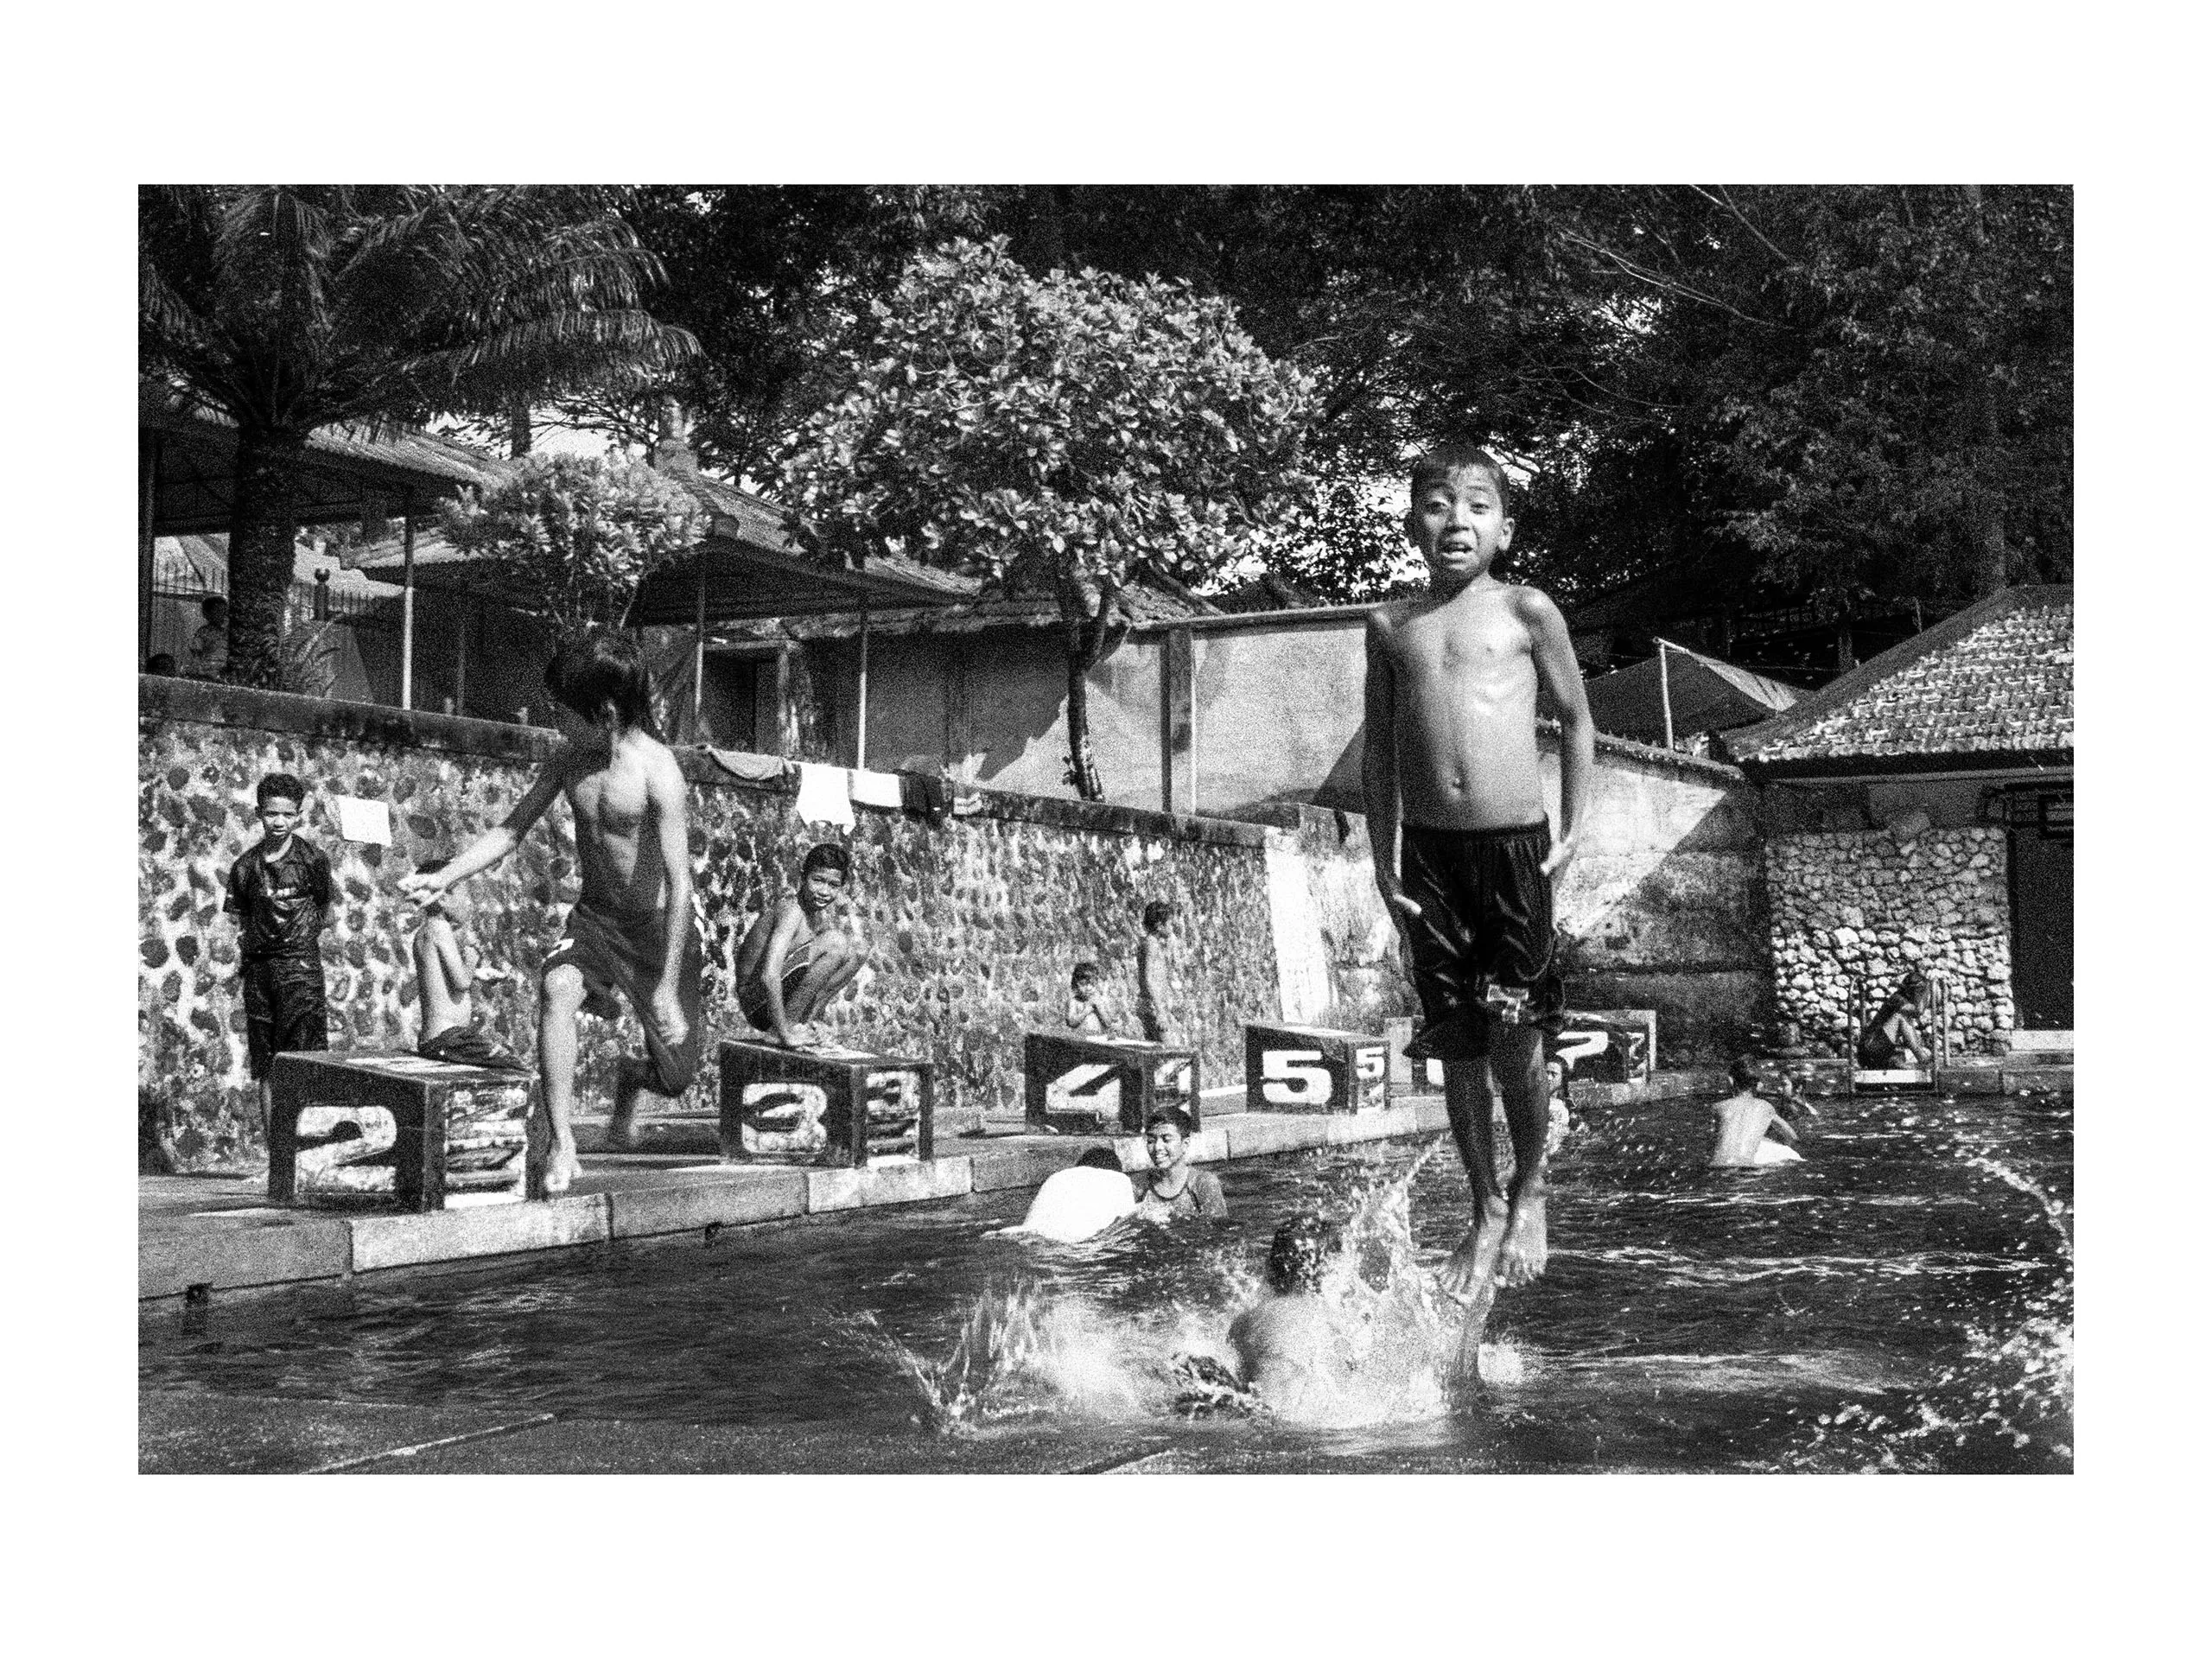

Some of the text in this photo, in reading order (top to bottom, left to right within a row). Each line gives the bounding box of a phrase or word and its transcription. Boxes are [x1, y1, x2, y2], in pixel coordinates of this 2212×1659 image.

[1262, 1050, 1332, 1104] 5
[1356, 1046, 1385, 1079] 5
[742, 1083, 828, 1154] 3
[1046, 1064, 1121, 1123] 4
[295, 1105, 397, 1194] 2
